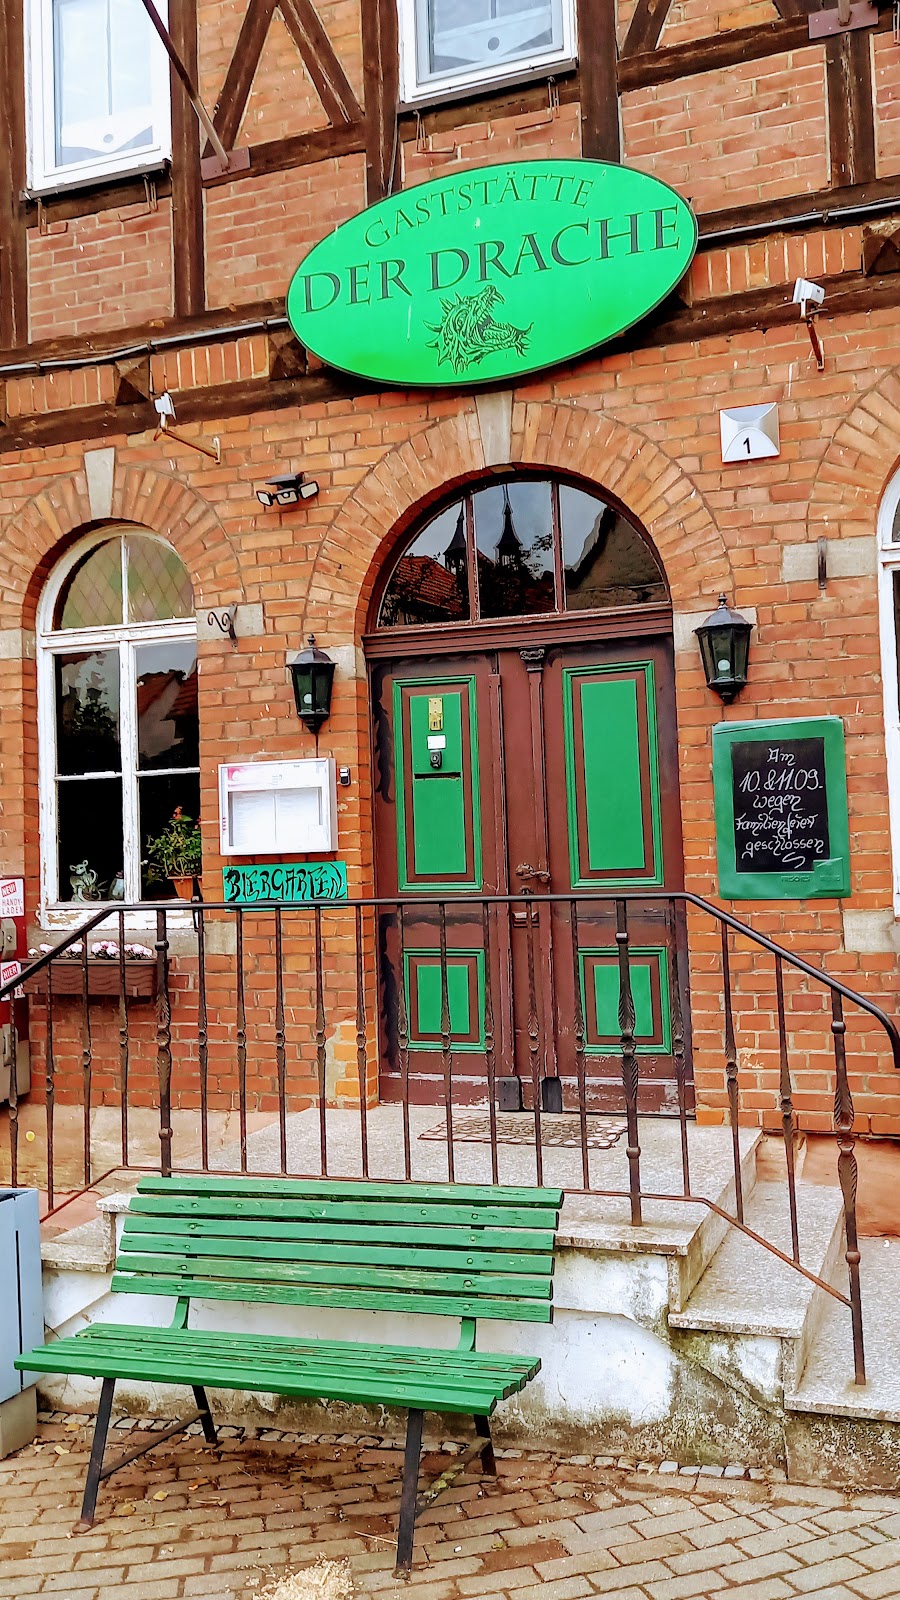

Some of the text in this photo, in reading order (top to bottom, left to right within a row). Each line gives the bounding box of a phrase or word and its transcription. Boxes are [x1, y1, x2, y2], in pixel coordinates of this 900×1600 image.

[364, 171, 594, 249] GASTSTÄTTE
[300, 203, 682, 315] DER DRACHE
[742, 437, 751, 454] 1
[767, 747, 796, 767] Am
[753, 794, 806, 815] wegen
[741, 835, 824, 859] geschlossen
[225, 866, 346, 902] BIERGARTEN
[2, 906, 23, 915] LADEN
[3, 965, 17, 979] HIER
